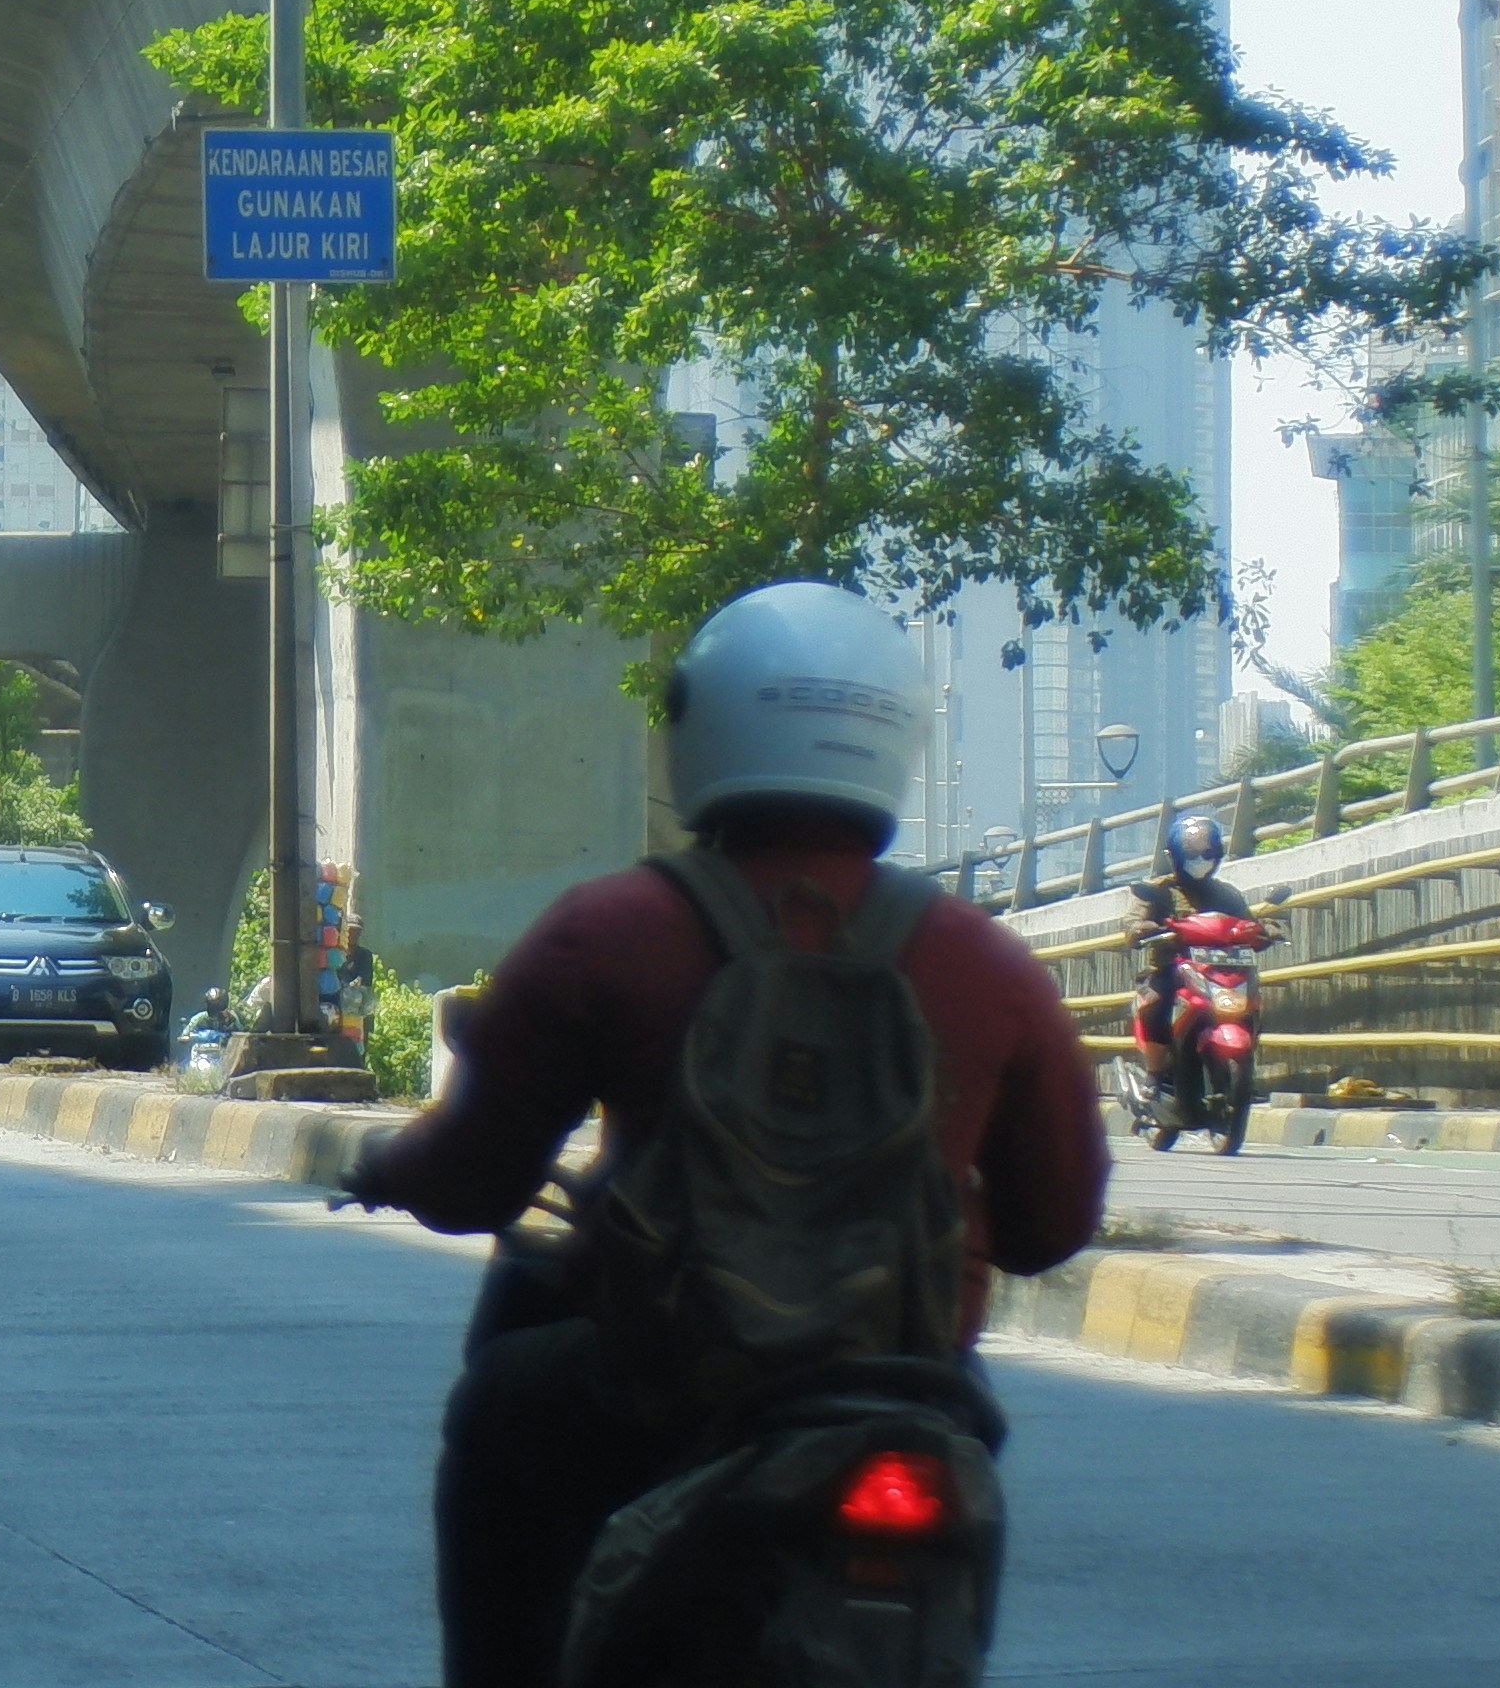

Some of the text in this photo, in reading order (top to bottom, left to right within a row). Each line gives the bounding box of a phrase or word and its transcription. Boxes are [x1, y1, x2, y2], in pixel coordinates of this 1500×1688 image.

[208, 148, 388, 177] KENDARAAN BESAR
[238, 189, 361, 219] GUNAKAN
[232, 232, 369, 260] LAJUR KIRI
